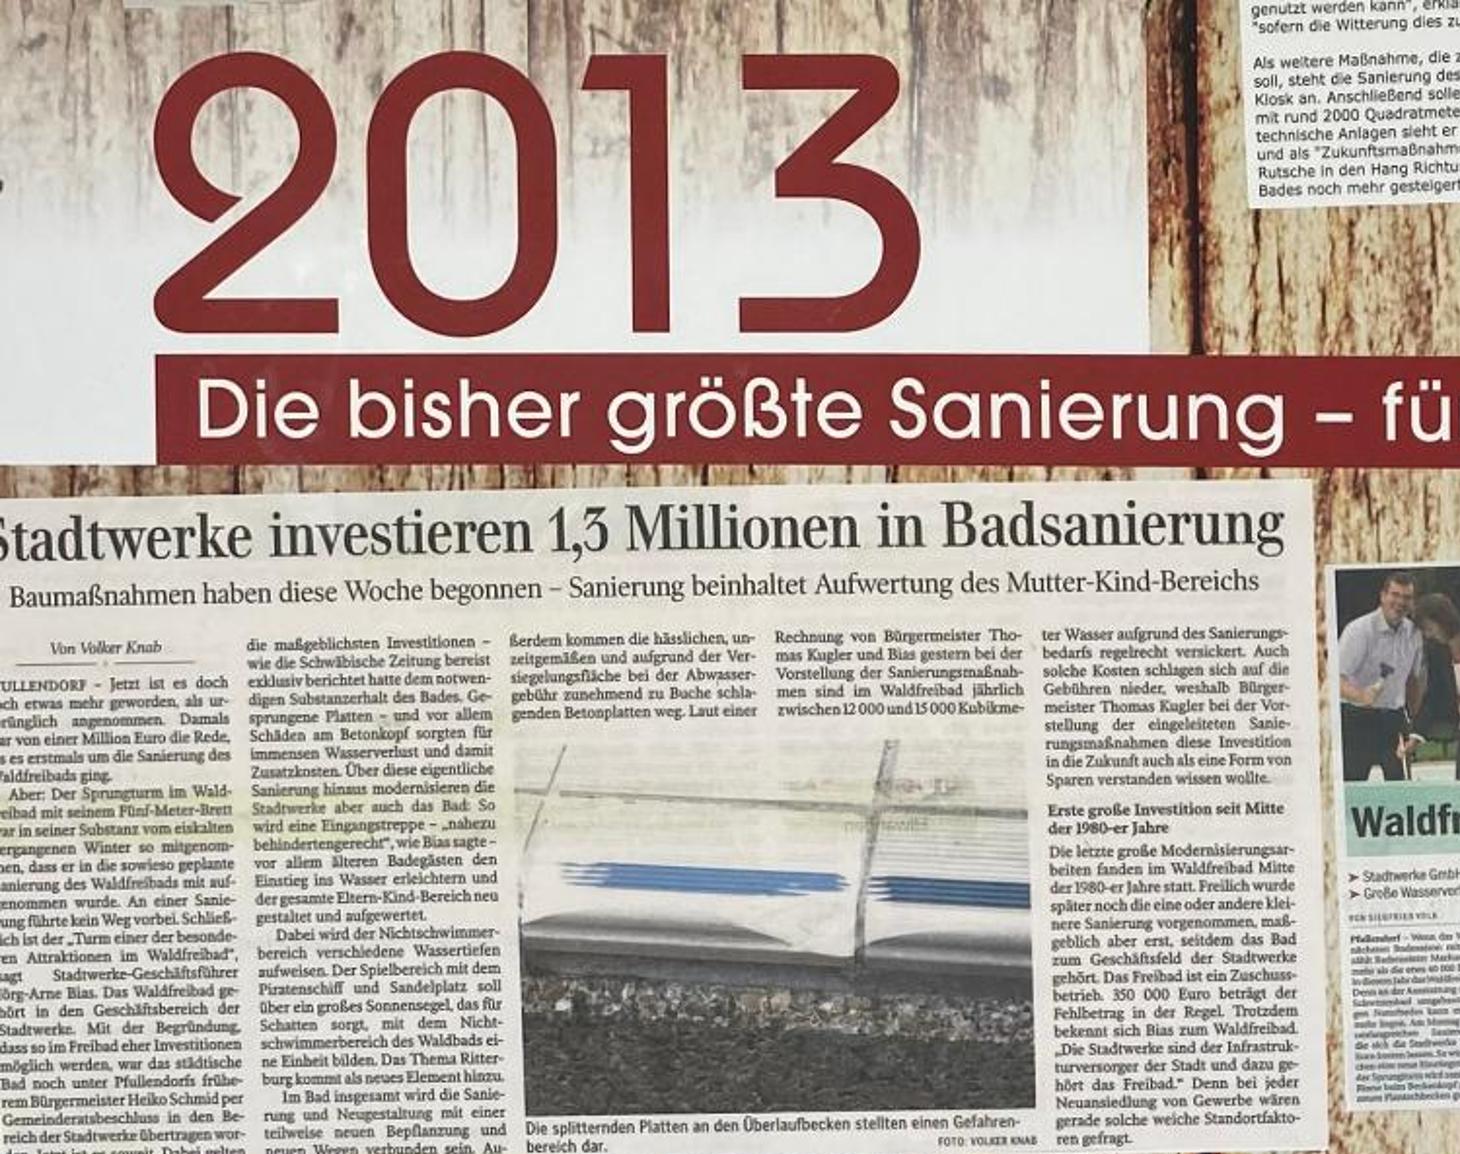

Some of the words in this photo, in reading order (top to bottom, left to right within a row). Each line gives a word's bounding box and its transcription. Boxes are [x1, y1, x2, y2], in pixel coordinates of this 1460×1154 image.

[1252, 55, 1275, 70] Als
[1279, 55, 1334, 69] weitere
[1338, 51, 1423, 67] Maßnahme,
[1428, 49, 1450, 64] die
[153, 50, 921, 338] 2013
[1258, 182, 1302, 197] Bades
[1306, 181, 1342, 195] noch
[1346, 179, 1385, 194] mehr
[198, 378, 319, 438] Die
[349, 377, 580, 438] bisher
[606, 376, 862, 454] größte
[889, 376, 1283, 455] Sanierung
[267, 508, 534, 557] investieren
[548, 505, 608, 563] 1,3
[624, 503, 861, 551] Millionen
[876, 501, 926, 548] in
[939, 499, 1285, 557] Badsanierung
[8, 582, 196, 608] Baumaßnahmen
[201, 580, 271, 604] haben
[278, 579, 337, 603] diese
[343, 578, 423, 602] Woche
[429, 577, 542, 606] begonnen
[568, 575, 685, 602] Sanierung
[690, 573, 807, 596] beinhaltet
[813, 572, 954, 600] Aufwertung
[960, 570, 999, 593] des
[1006, 567, 1260, 593] Mutter-Kind-Bereichs
[49, 641, 76, 655] Von
[80, 640, 123, 654] Volker
[124, 639, 162, 654] Knab
[1047, 803, 1084, 817] Erste
[1087, 802, 1130, 820] große
[1133, 802, 1212, 816] Investition
[1215, 802, 1241, 815] seit
[1244, 802, 1284, 815] Mitte
[1362, 867, 1427, 882] Stadtwerke
[1363, 885, 1398, 900] Große
[524, 1120, 548, 1135] Die
[551, 1119, 635, 1138] splitternden
[638, 1118, 688, 1134] Platten
[692, 1121, 709, 1133] an
[713, 1118, 739, 1132] den
[742, 1116, 851, 1133] Überlaufbecken
[854, 1115, 907, 1130] stellten
[910, 1115, 948, 1129] einen
[952, 1113, 1020, 1129] Gefahren-
[525, 1138, 577, 1153] bereich
[581, 1138, 608, 1153] dar.
